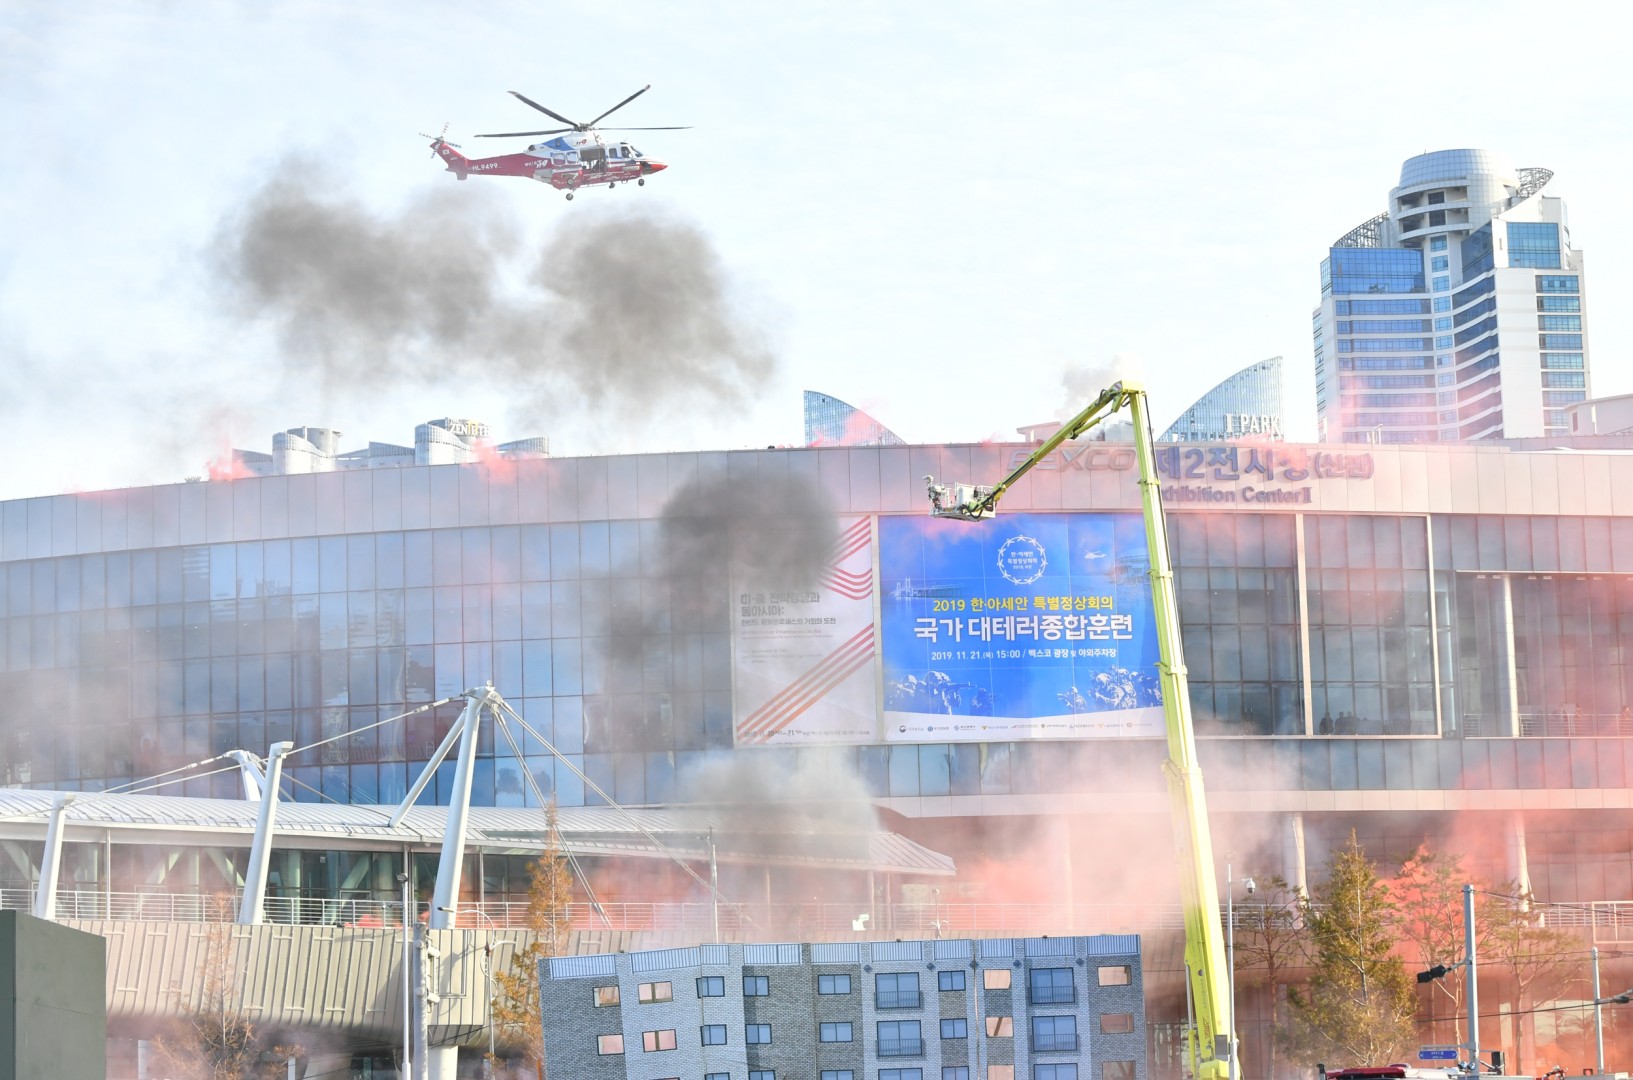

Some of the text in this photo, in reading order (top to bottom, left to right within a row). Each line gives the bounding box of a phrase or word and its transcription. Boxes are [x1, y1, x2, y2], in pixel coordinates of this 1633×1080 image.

[472, 162, 498, 171] HL9499
[1240, 413, 1281, 435] PARK
[1161, 486, 1236, 503] xhibition
[933, 599, 966, 612] 2019
[1033, 595, 1113, 611] 특별정상회의
[914, 613, 1133, 643] 국가 대테러종합훈련
[996, 649, 1021, 659] 15:00
[1054, 648, 1069, 658] 광장
